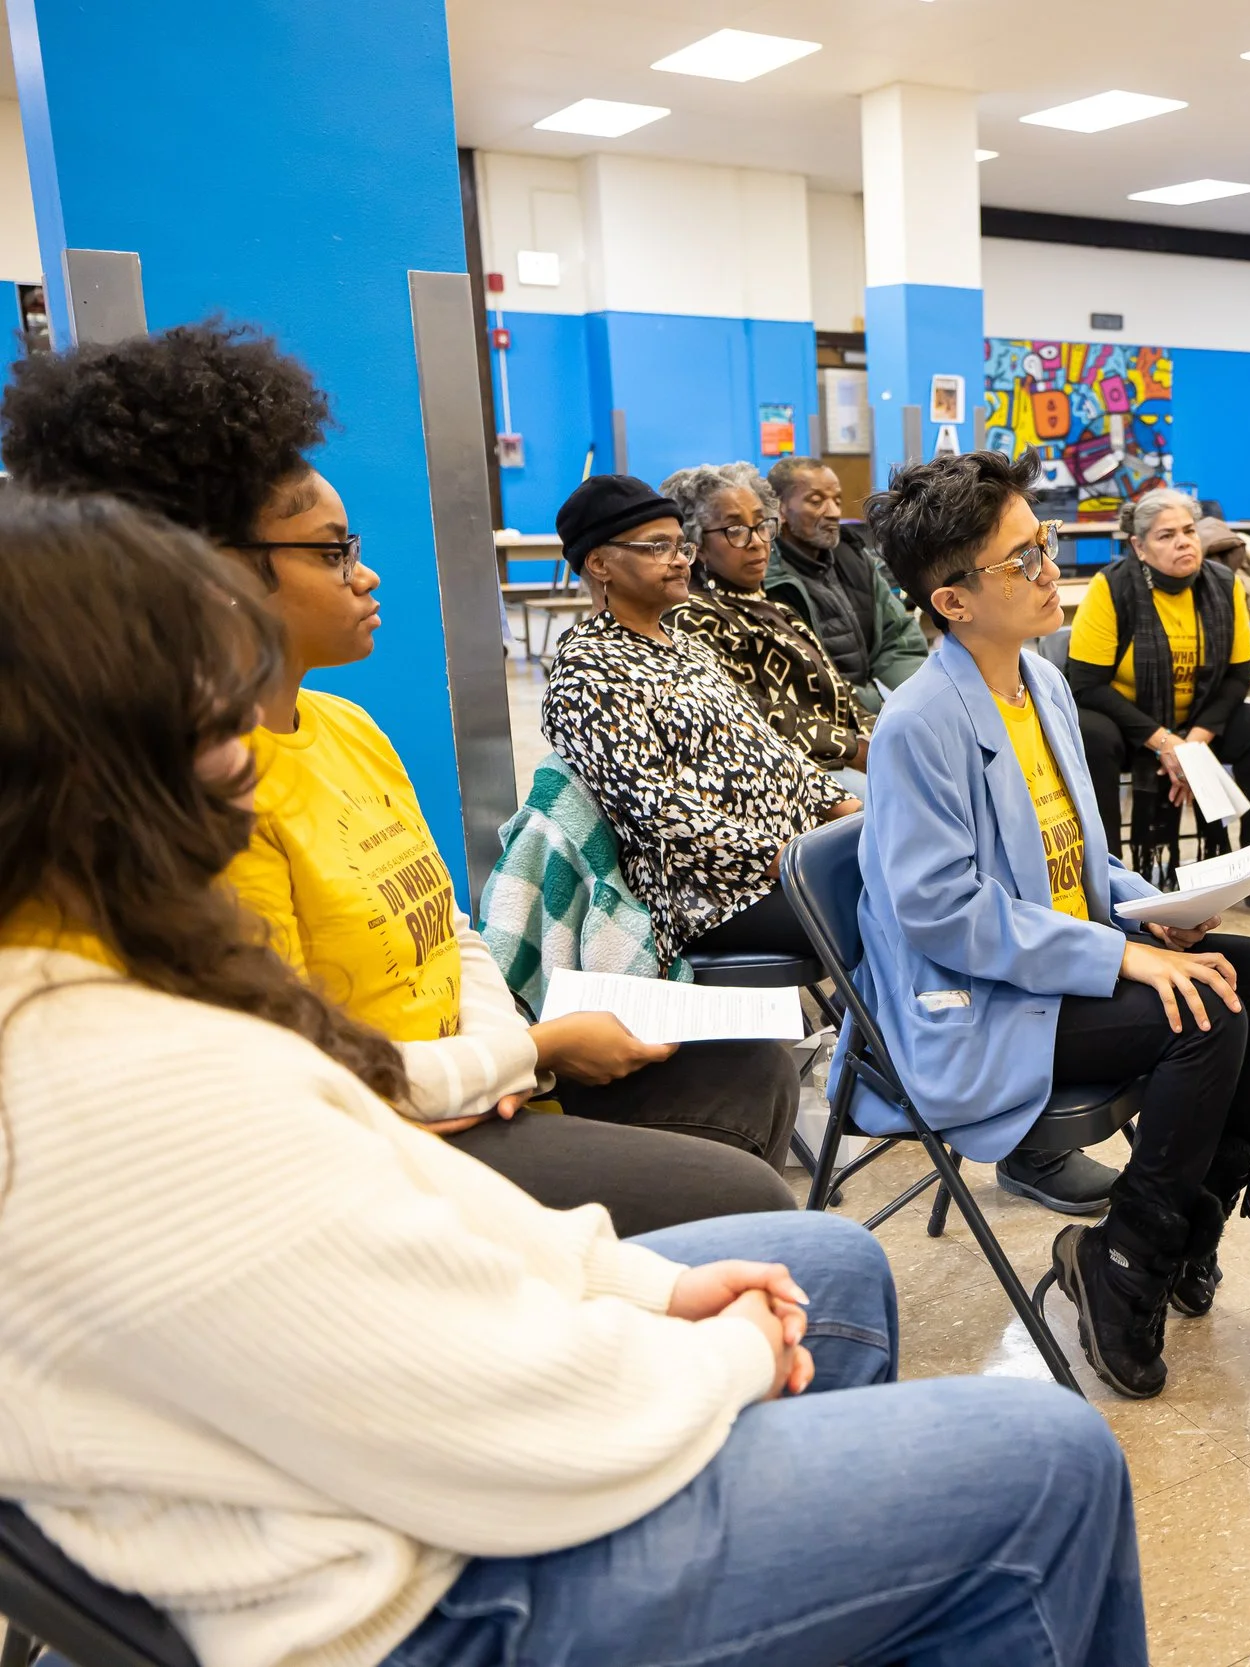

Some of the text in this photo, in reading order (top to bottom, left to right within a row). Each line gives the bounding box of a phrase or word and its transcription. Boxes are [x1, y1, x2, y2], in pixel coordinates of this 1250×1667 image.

[1041, 830, 1052, 856] O
[1047, 844, 1083, 895] RIGH
[377, 878, 406, 917] DO
[394, 854, 442, 904] WHAT
[405, 886, 455, 967] RIGHT
